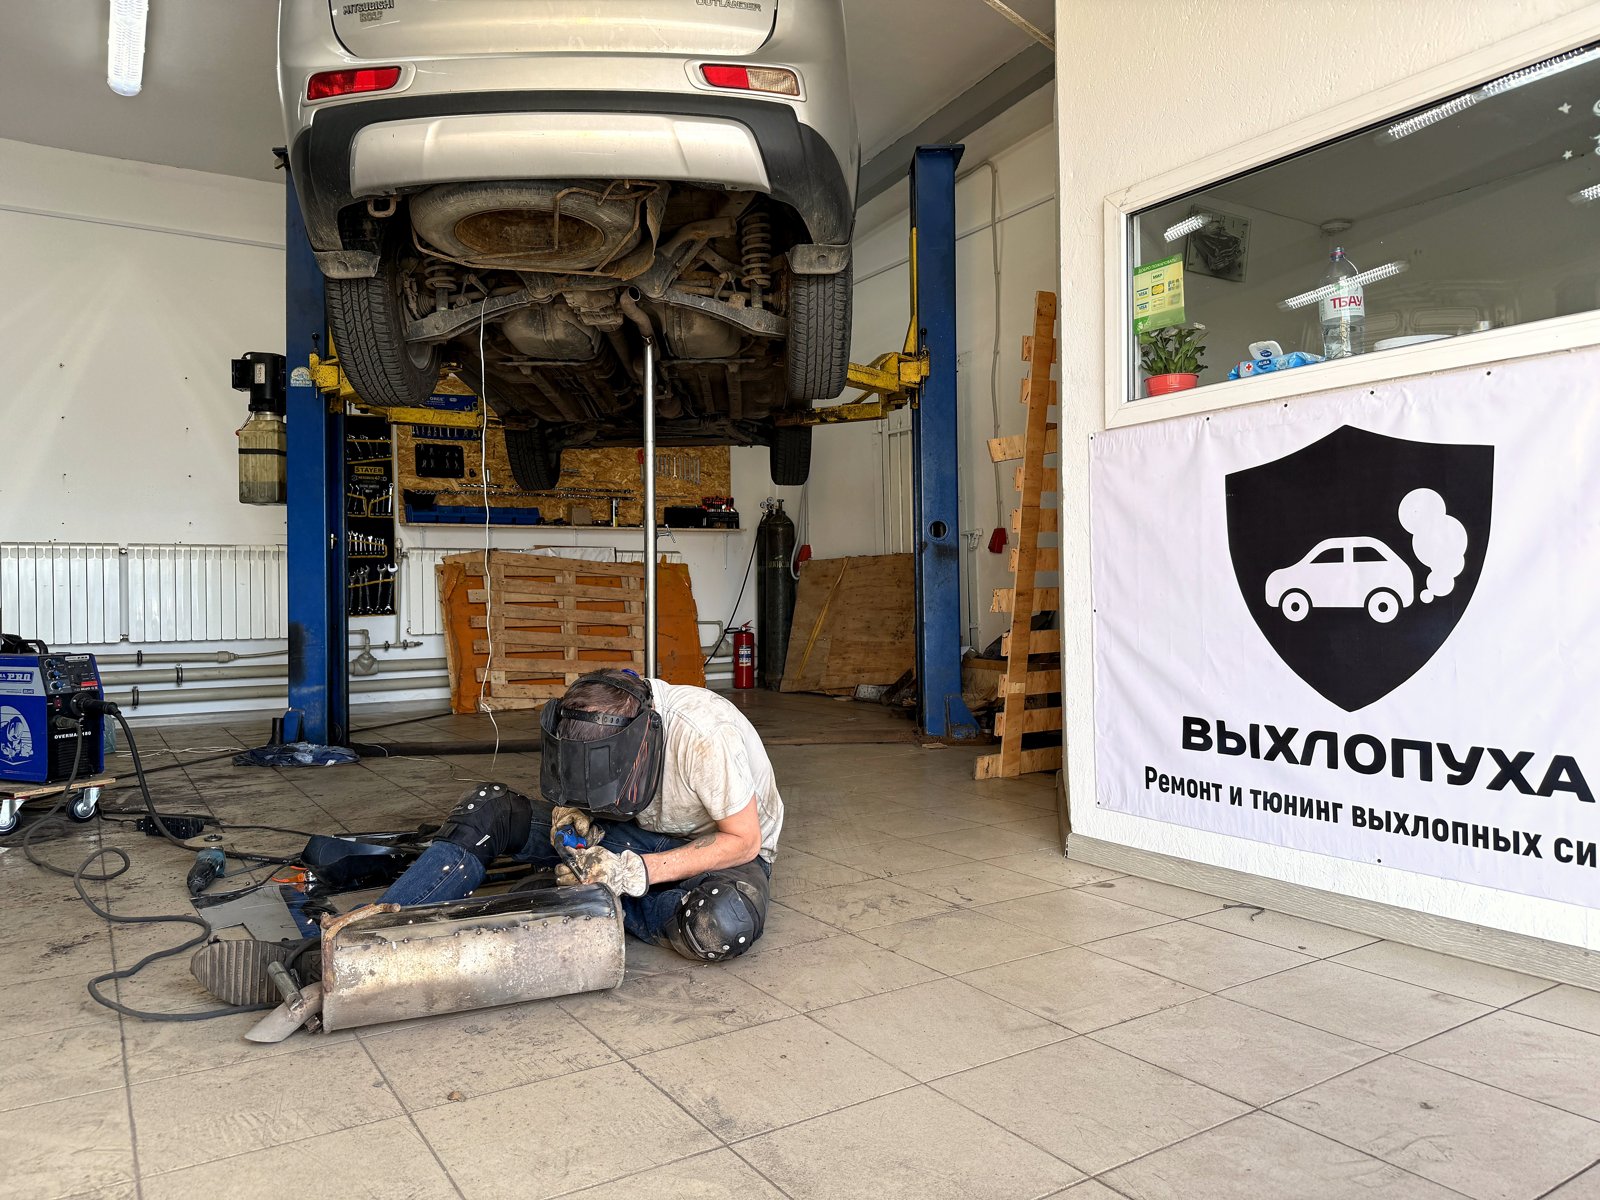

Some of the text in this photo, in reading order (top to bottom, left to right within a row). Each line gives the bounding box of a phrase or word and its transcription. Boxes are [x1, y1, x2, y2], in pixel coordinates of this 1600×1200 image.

[343, 0, 394, 15] MITSUBISHI
[695, 0, 761, 11] OUTLANDER
[1330, 295, 1363, 309] ТБАУ
[7, 673, 31, 681] PRO
[54, 732, 79, 740] OVERMA
[1182, 716, 1596, 803] ВЫХЛОПУХА
[1145, 766, 1223, 803] Ремонт
[1229, 785, 1243, 806] и
[1250, 789, 1343, 823] тюнинг
[1352, 805, 1543, 859] выхлопных
